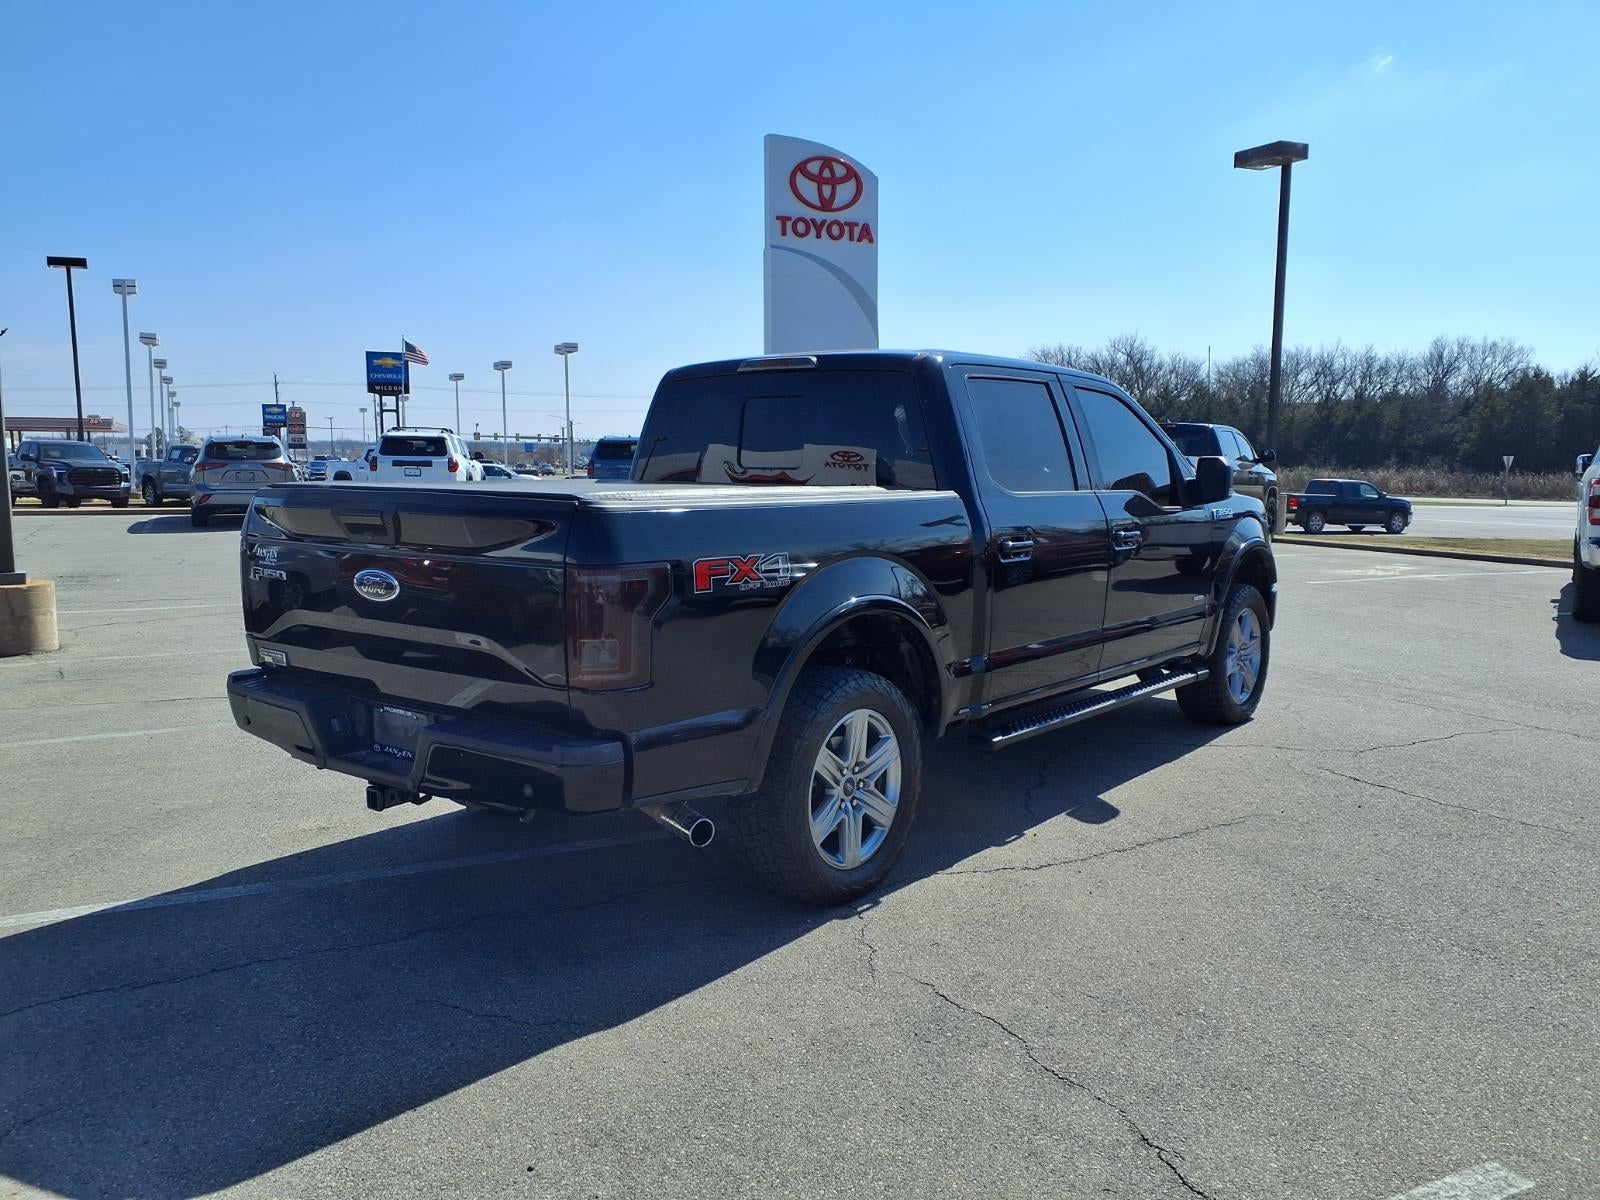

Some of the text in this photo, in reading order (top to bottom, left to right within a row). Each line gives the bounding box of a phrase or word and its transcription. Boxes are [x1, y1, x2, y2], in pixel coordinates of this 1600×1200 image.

[776, 215, 874, 244] TOYOTA
[361, 575, 387, 595] Ford
[692, 552, 791, 594] FX4
